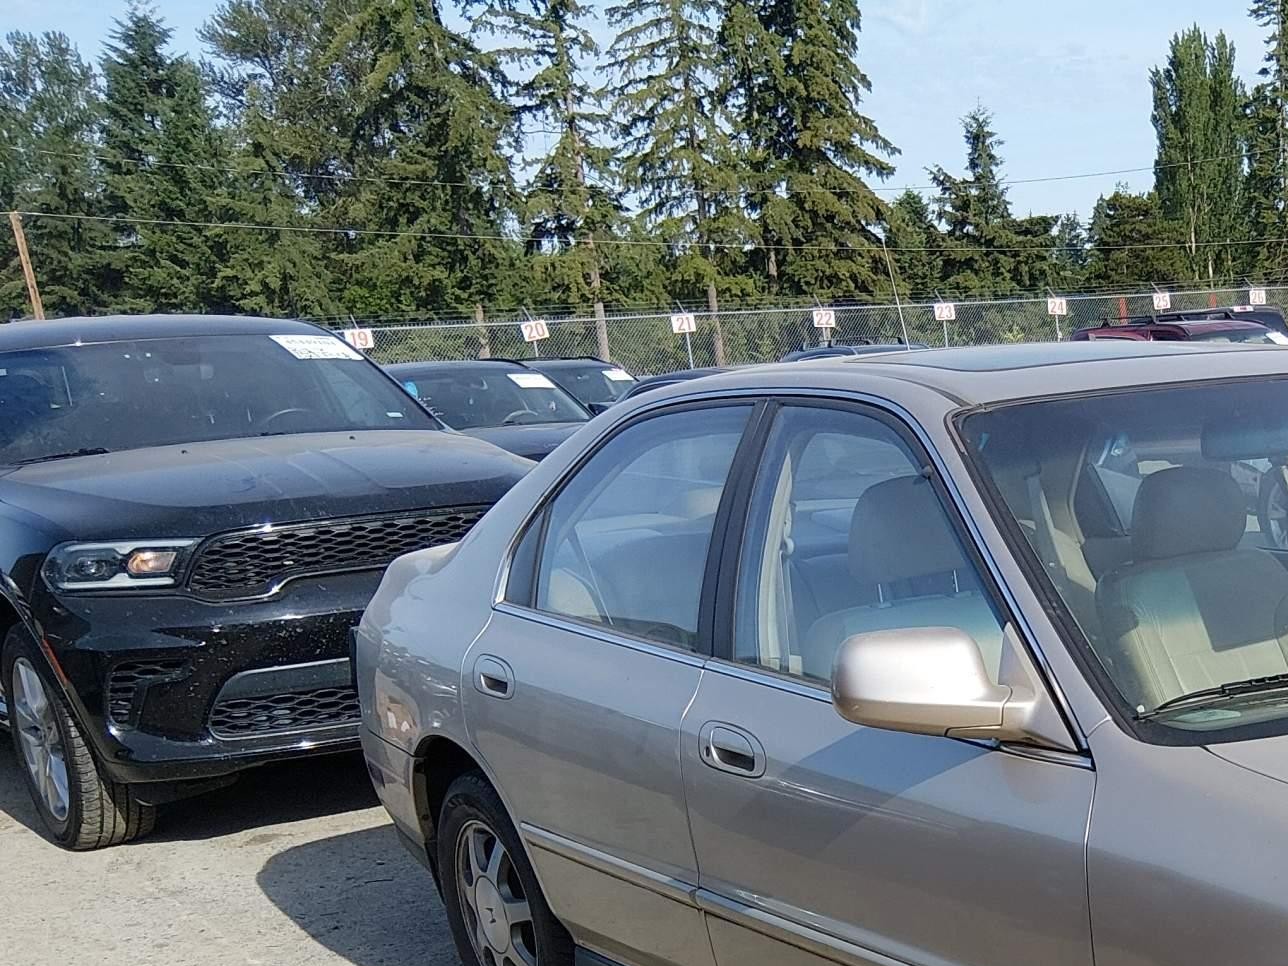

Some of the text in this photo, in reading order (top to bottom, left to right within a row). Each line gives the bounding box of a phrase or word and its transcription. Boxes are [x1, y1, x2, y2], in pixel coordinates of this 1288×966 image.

[1155, 295, 1168, 308] 25
[1252, 291, 1264, 303] 26
[937, 306, 952, 318] 23
[1050, 301, 1064, 313] 24
[677, 317, 691, 331] 21
[816, 312, 833, 325] 22
[525, 322, 545, 340] 20
[350, 331, 368, 346] 19
